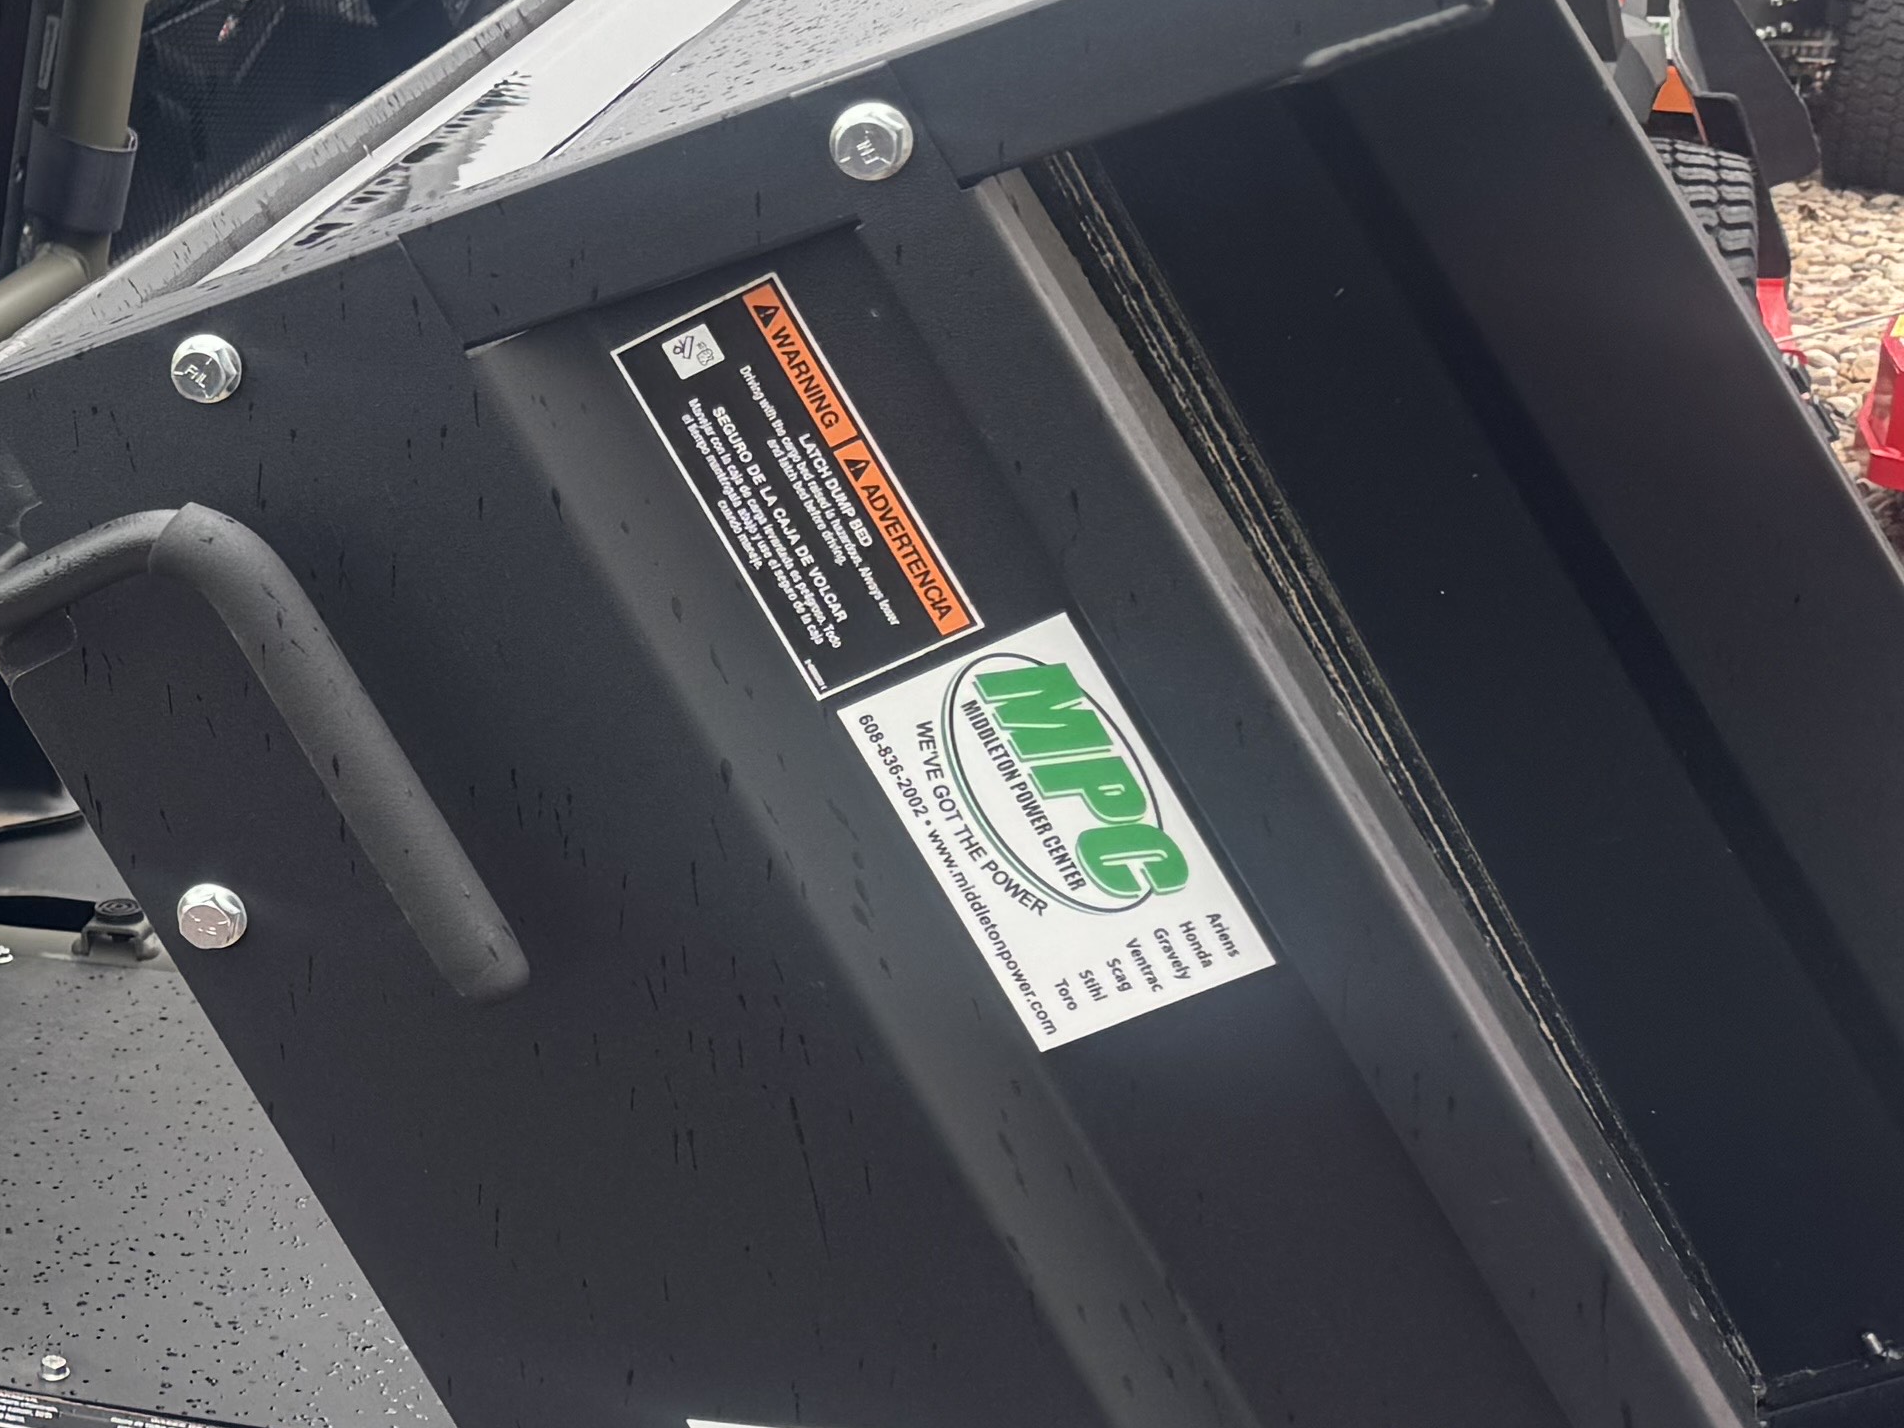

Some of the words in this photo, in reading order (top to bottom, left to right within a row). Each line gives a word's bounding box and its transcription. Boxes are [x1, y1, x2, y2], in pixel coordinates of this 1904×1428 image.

[771, 325, 839, 430] WARNING
[739, 365, 765, 401] Driving
[759, 398, 777, 421] with
[771, 419, 787, 437] the
[781, 436, 802, 463] cargo
[796, 460, 815, 481] bed
[807, 480, 832, 509] raised
[712, 406, 753, 463] SEGURO
[746, 463, 767, 486] DE
[759, 485, 778, 507] LA
[773, 507, 801, 546] CAJA
[794, 544, 815, 567] DE
[808, 566, 848, 623] VOLCAR
[792, 480, 811, 501] bed
[803, 499, 827, 531] before
[798, 433, 833, 479] LATCH
[824, 477, 856, 517] DUMP
[848, 518, 873, 547] BED
[860, 484, 952, 621] ADVERTENCIA
[916, 720, 961, 781] WE'VE
[932, 784, 964, 821] GOT
[961, 699, 1022, 782] MIDDLETON
[1010, 781, 1053, 836] POWER
[1042, 835, 1087, 891] CENTER
[973, 662, 1190, 900] MPC
[954, 823, 988, 862] THE
[858, 714, 929, 818] 608-836-2002
[928, 829, 1057, 1035] www.middletonpower.com
[980, 848, 1048, 916] POWER
[1153, 927, 1191, 980] Gravely
[1179, 920, 1213, 968] Honda
[1205, 913, 1240, 958] Ariens
[1078, 969, 1108, 1002] Stihl
[1106, 957, 1133, 992] Scag
[1126, 937, 1163, 993] Ventrac
[1054, 978, 1078, 1011] Toro
